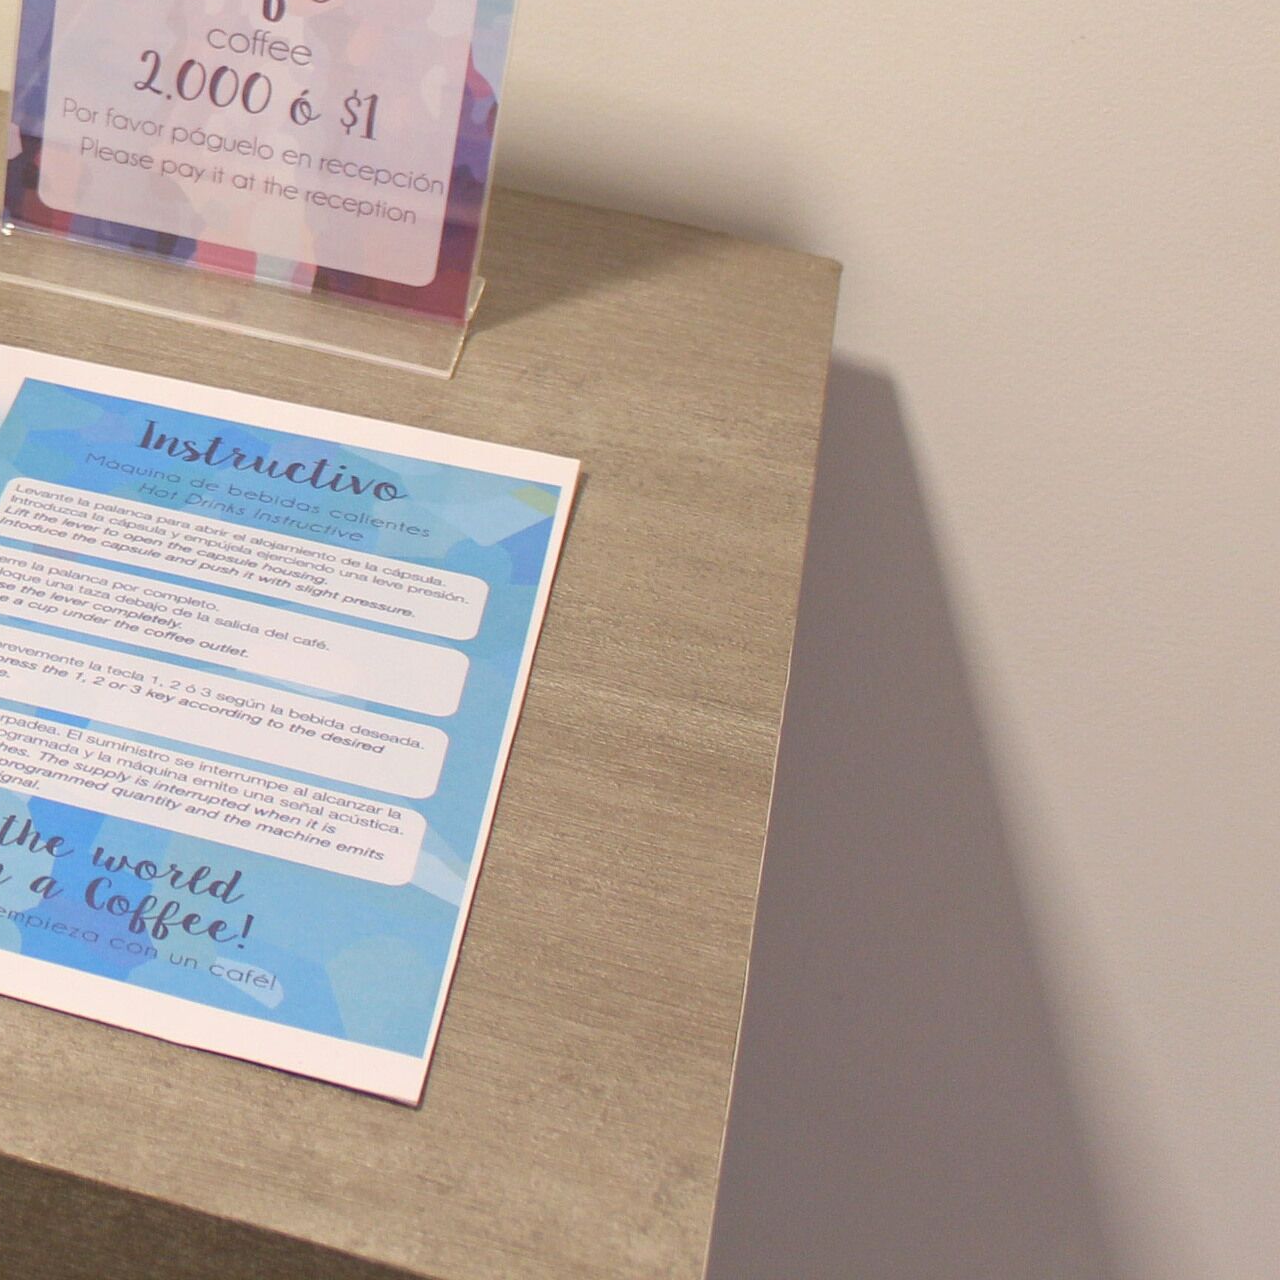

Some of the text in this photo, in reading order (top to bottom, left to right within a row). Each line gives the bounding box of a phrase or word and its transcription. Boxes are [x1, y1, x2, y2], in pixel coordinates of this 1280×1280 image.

[207, 29, 312, 65] coffee
[134, 50, 378, 140] 2.000 ó $1
[63, 97, 445, 195] Por favor páguelo en recepción
[80, 136, 417, 225] Please pay it at the reception
[85, 452, 430, 538] Máquina de bebidas calientes
[137, 420, 408, 500] Instructivo
[3, 505, 328, 586] Lift the lever to open the capsule housing.
[137, 482, 364, 542] Hot Drinks Instructive
[19, 585, 46, 598] the
[49, 591, 90, 607] lever
[91, 602, 182, 630] completely.
[30, 561, 45, 572] la
[46, 566, 109, 586] palanca
[111, 581, 140, 593] por
[142, 588, 219, 612] completo.
[71, 532, 97, 544] the
[100, 540, 162, 558] capsule
[163, 554, 198, 566] and
[197, 561, 240, 576] push
[242, 570, 255, 580] it
[257, 575, 292, 588] with
[294, 584, 340, 600] slight
[340, 595, 415, 618] pressure.
[11, 597, 24, 606] a
[27, 601, 59, 614] cup
[61, 608, 112, 625] under
[113, 619, 140, 632] the
[143, 627, 195, 645] coffee
[198, 640, 249, 658] outlet.
[41, 664, 69, 678] the
[75, 671, 86, 683] 1,
[91, 675, 106, 686] 2
[107, 681, 128, 690] or
[129, 684, 143, 695] 3
[144, 688, 176, 704] key
[177, 697, 263, 726] according
[266, 717, 285, 729] to
[288, 723, 317, 737] the
[320, 732, 386, 754] desired
[30, 875, 64, 900] a
[85, 877, 255, 949] Coffee!
[92, 847, 245, 904] world
[109, 938, 159, 960] con
[169, 953, 198, 970] un
